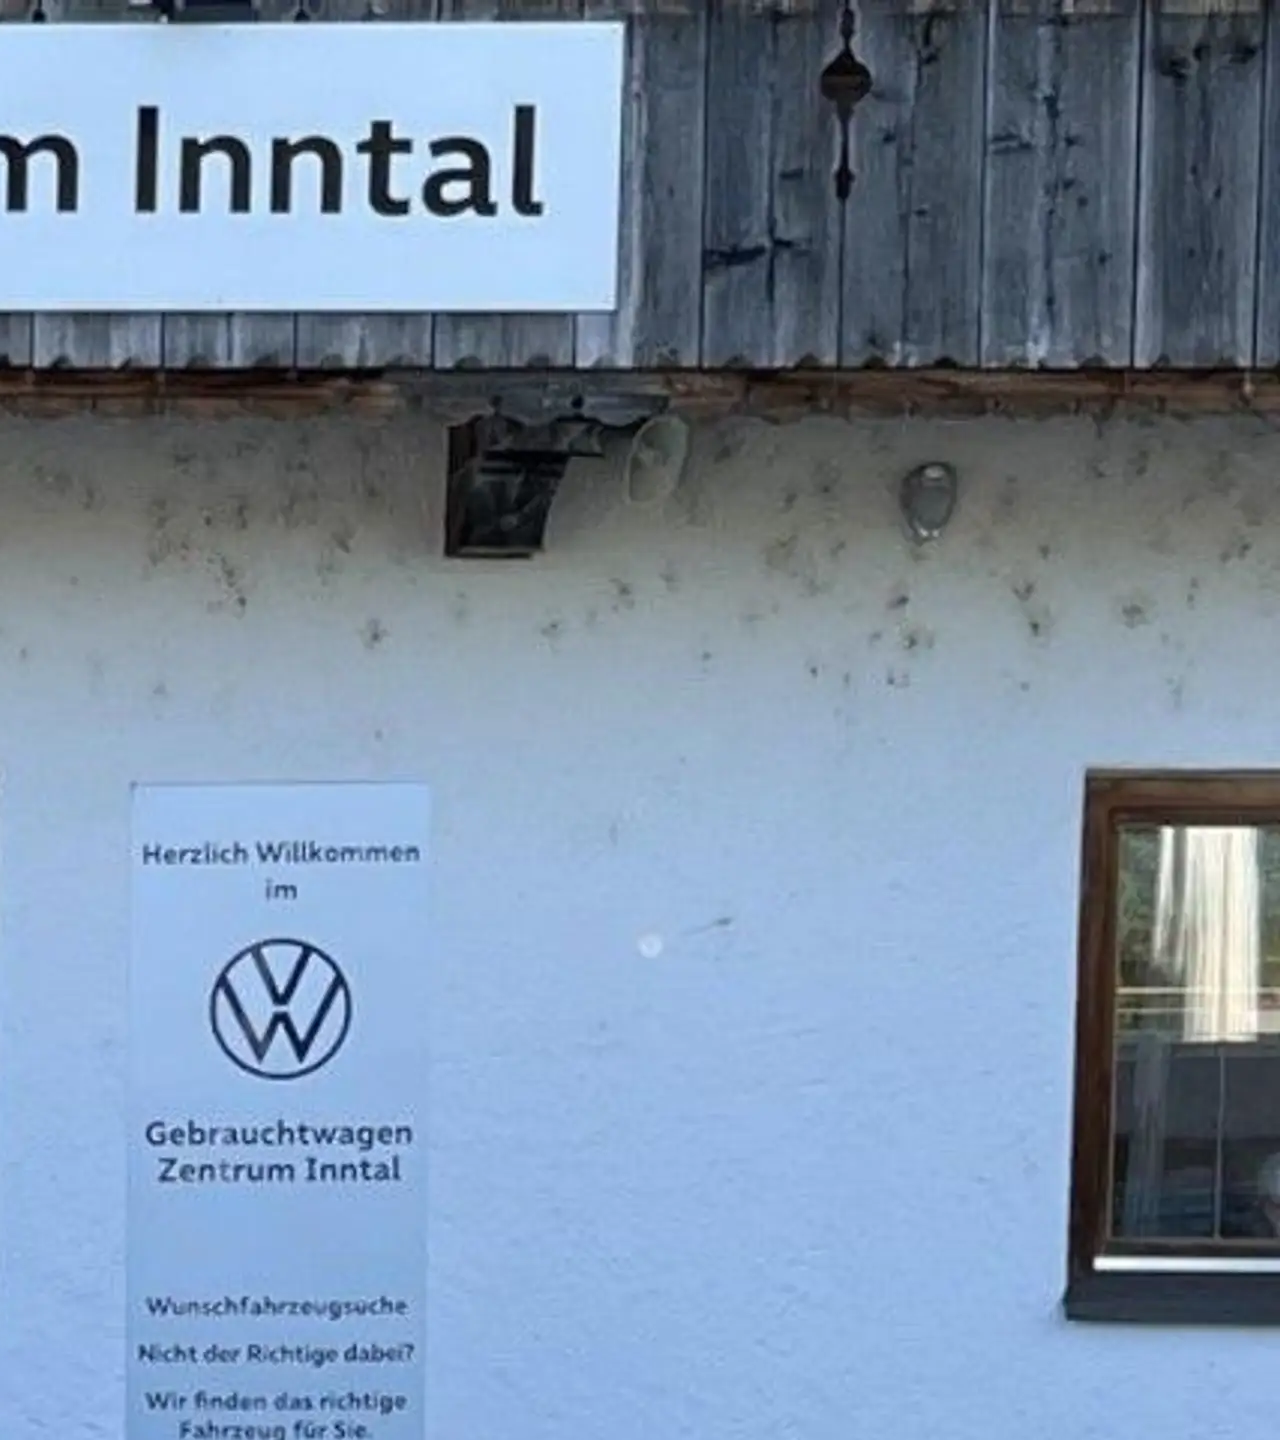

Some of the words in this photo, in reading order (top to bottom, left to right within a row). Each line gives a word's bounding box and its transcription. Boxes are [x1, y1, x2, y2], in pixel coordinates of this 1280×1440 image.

[136, 105, 543, 216] Inntal
[143, 842, 248, 864] Herzlich
[257, 841, 419, 863] Willkommen
[266, 880, 297, 899] im
[146, 1120, 412, 1151] Gebrauchtwagen
[158, 1158, 295, 1183] Zentrum
[306, 1155, 400, 1181] Inntal
[146, 1296, 407, 1321] Wunschfahrzeugsuche
[139, 1345, 197, 1363] Nicht
[203, 1344, 240, 1363] der
[247, 1344, 338, 1368] Richtige
[344, 1344, 414, 1362] dabei?
[146, 1393, 187, 1409] Wir
[195, 1391, 266, 1411] finden
[274, 1393, 313, 1410] das
[320, 1392, 406, 1415] richtige
[294, 1420, 327, 1439] für
[334, 1421, 372, 1439] Sie.
